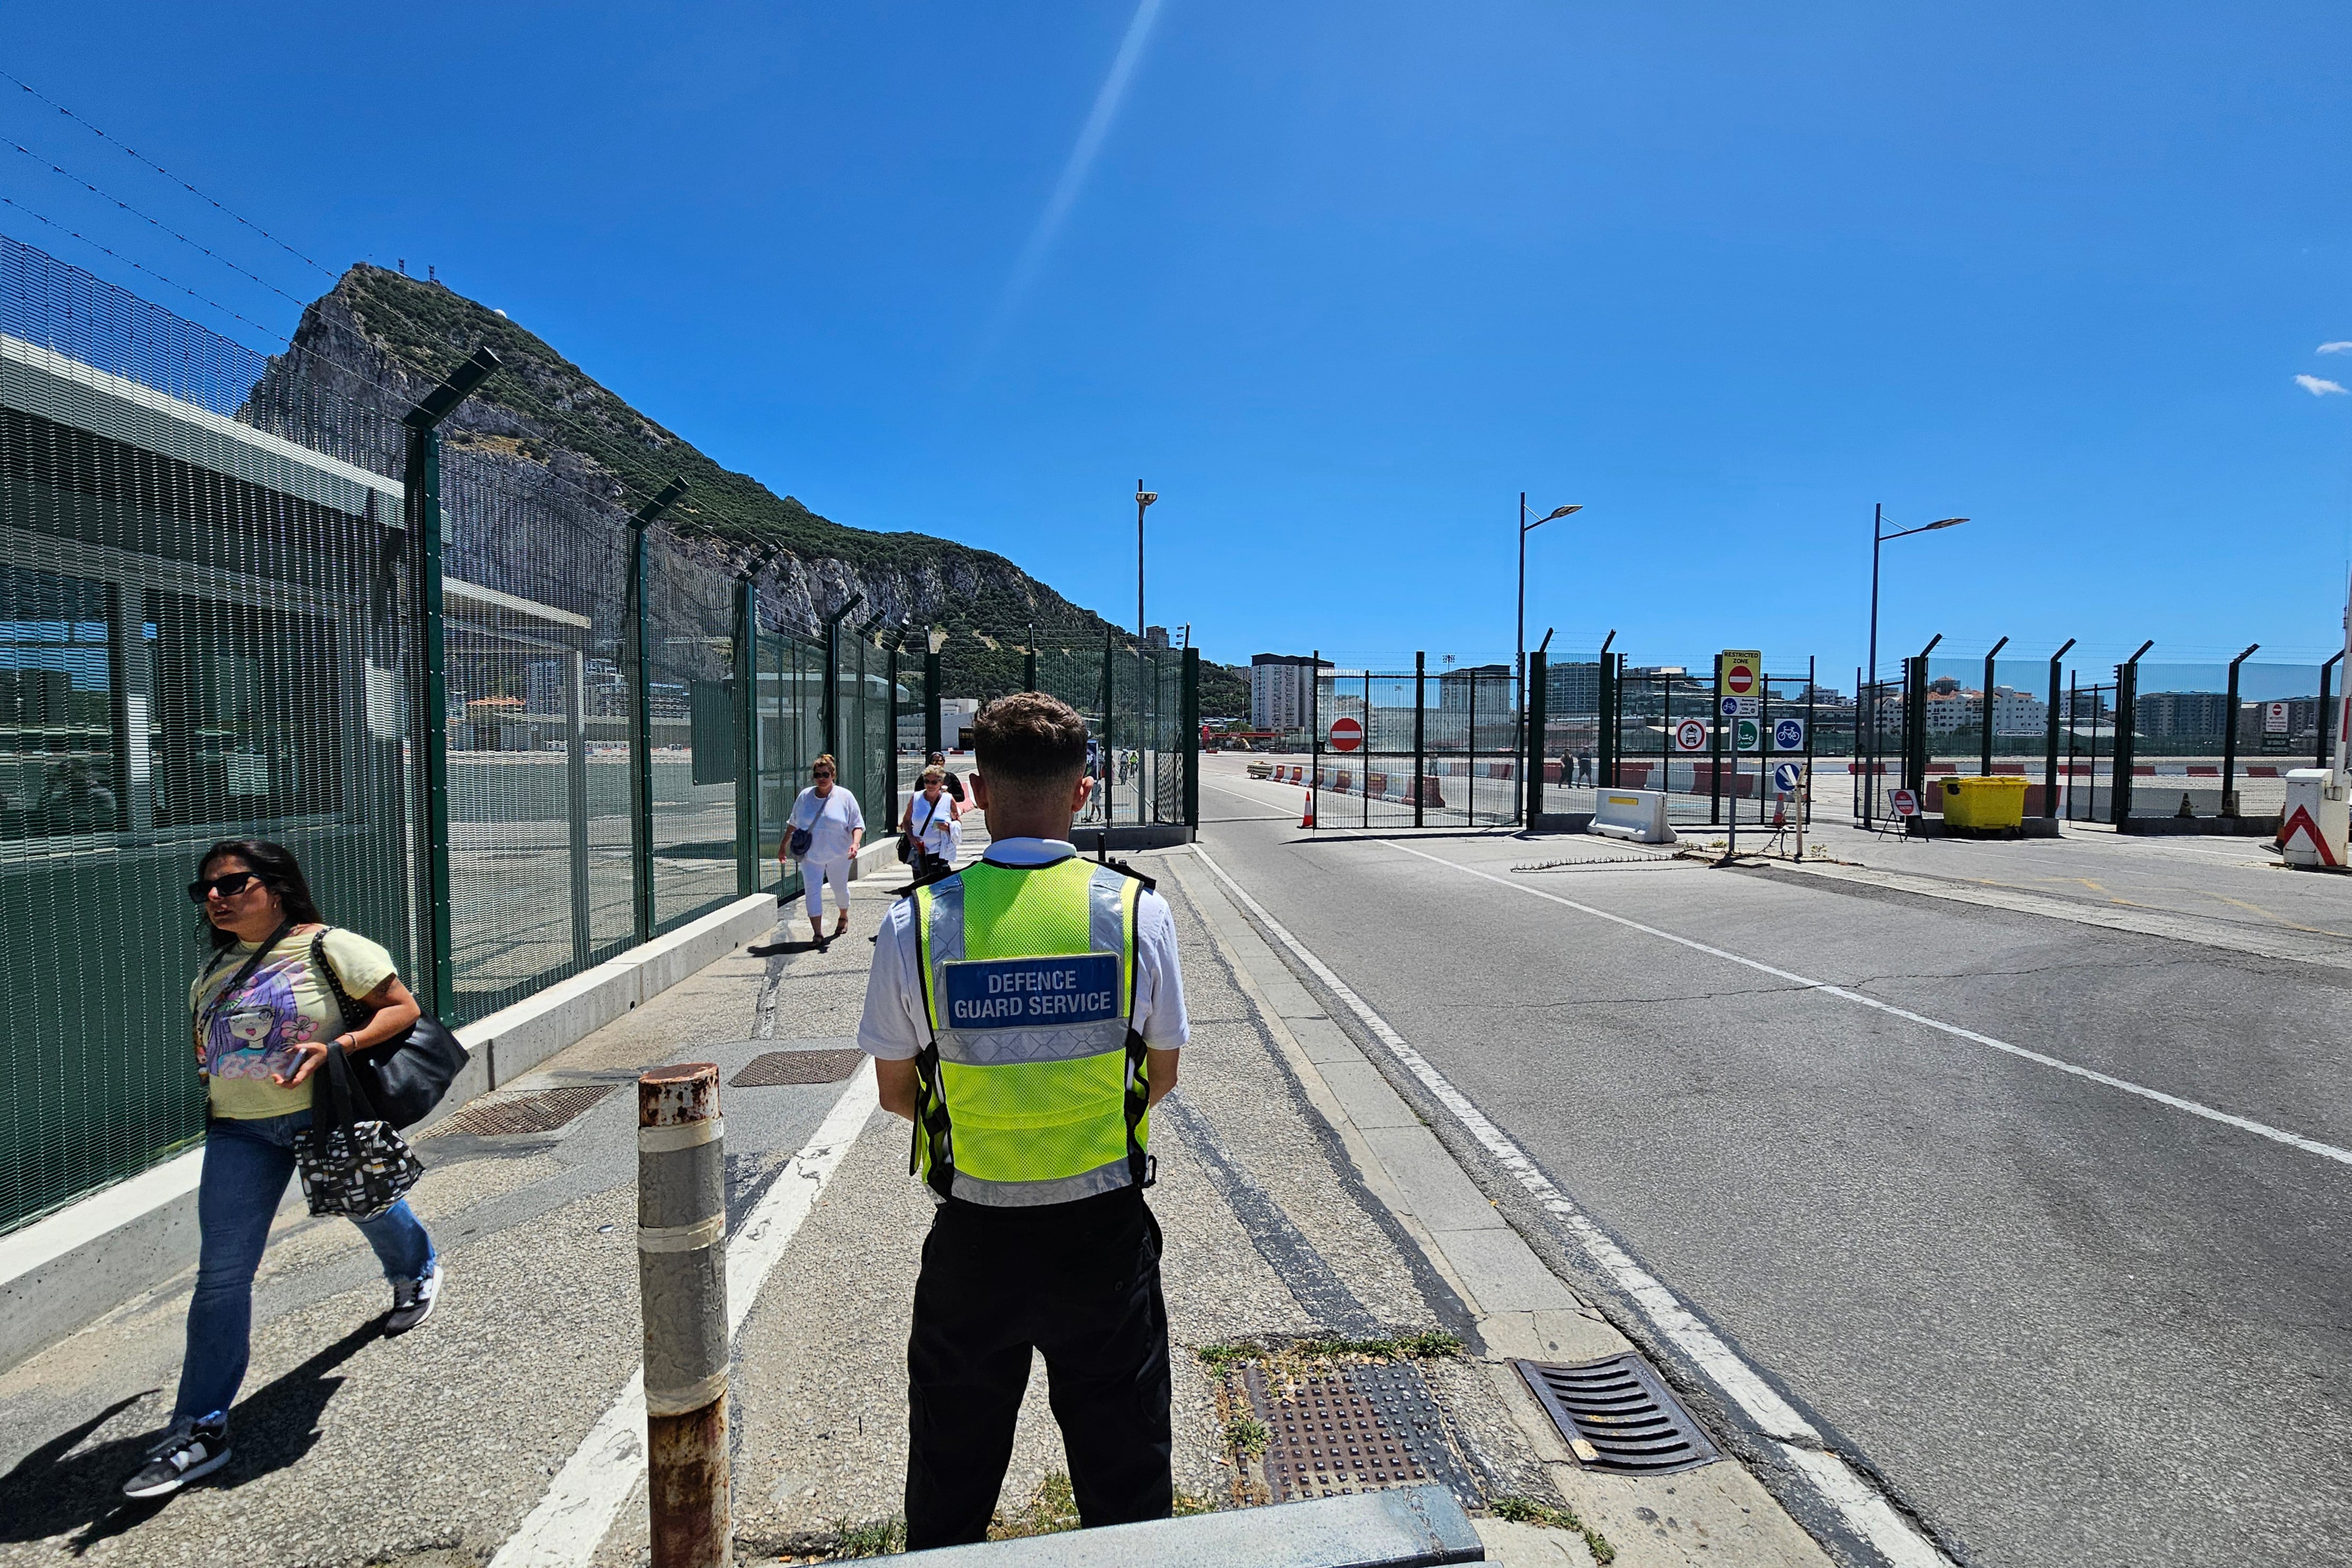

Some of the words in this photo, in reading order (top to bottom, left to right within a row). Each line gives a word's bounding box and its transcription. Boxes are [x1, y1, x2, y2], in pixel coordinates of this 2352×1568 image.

[988, 970, 1076, 993] DEFENCE
[954, 997, 1022, 1018] GUARD
[1029, 991, 1110, 1015] SERVICE
